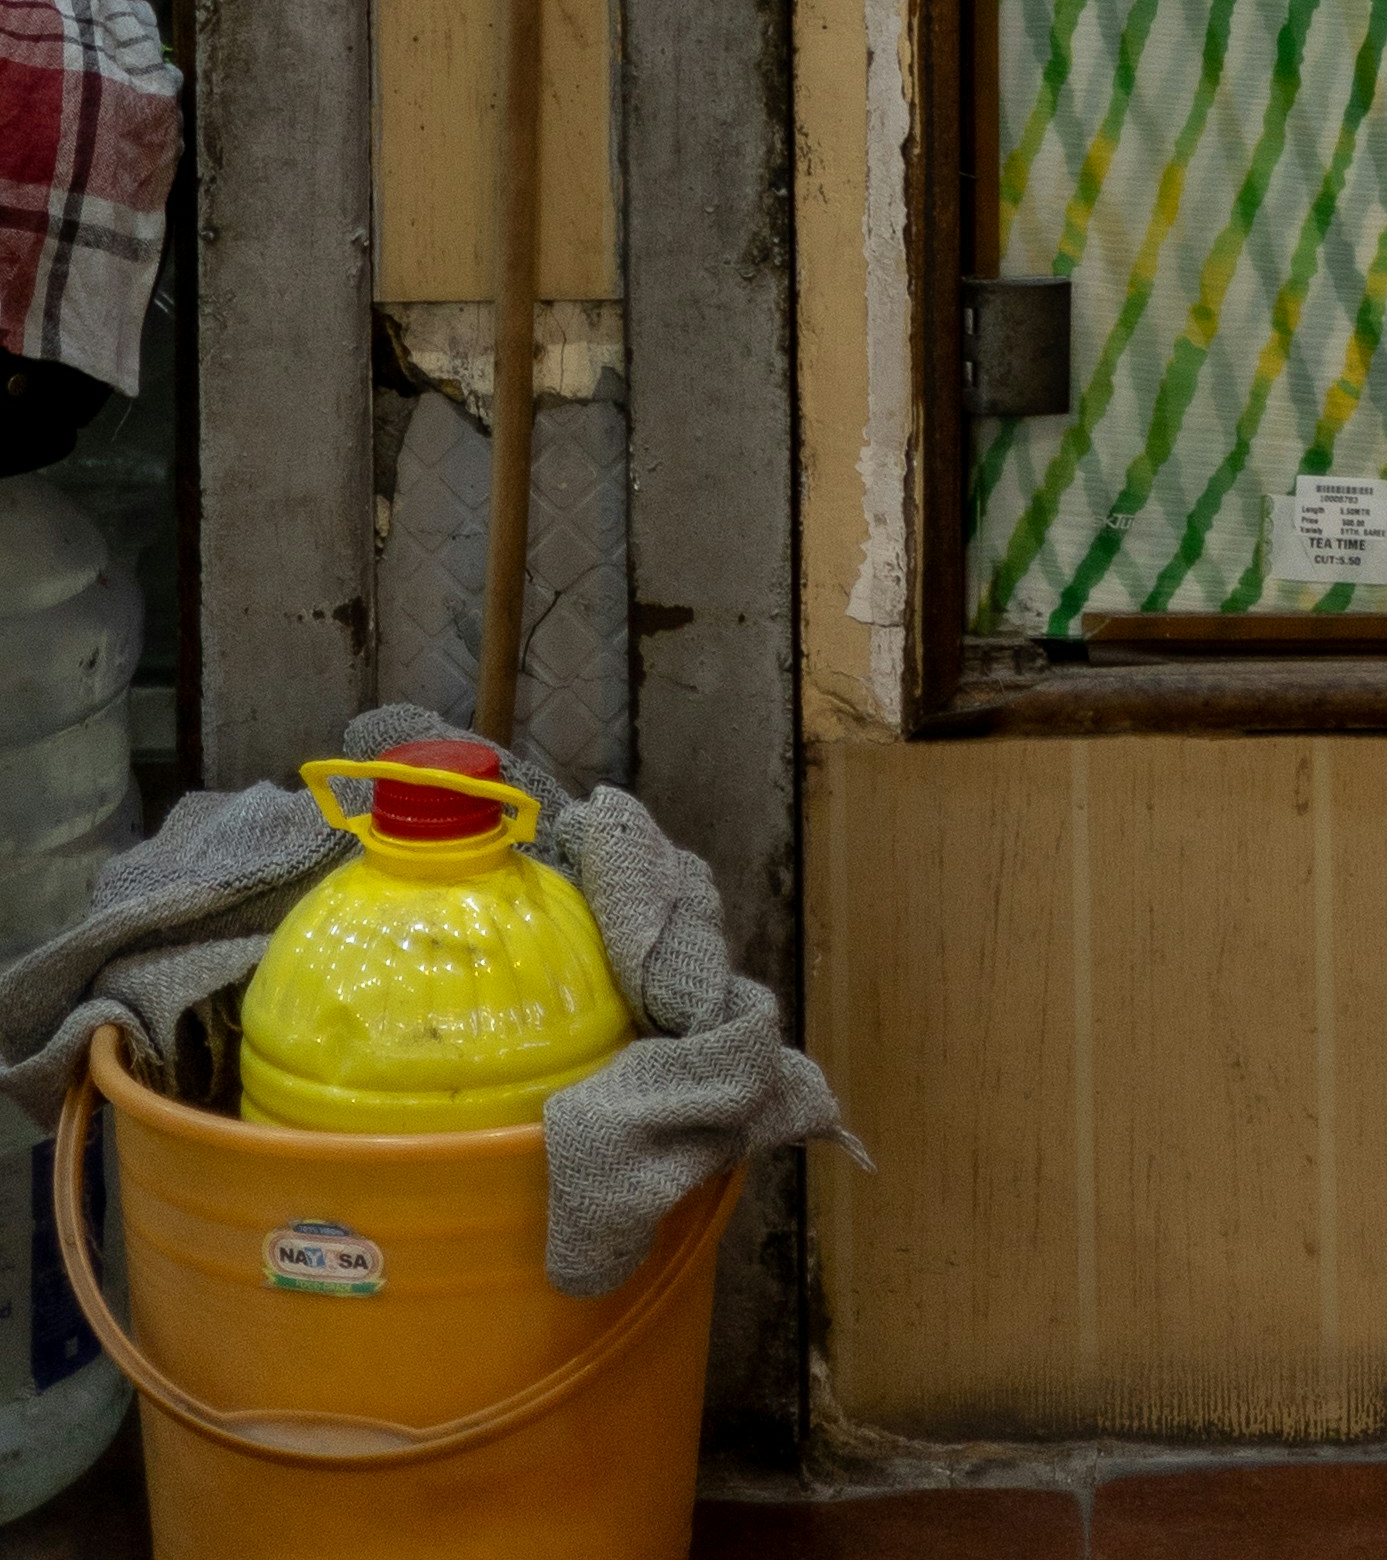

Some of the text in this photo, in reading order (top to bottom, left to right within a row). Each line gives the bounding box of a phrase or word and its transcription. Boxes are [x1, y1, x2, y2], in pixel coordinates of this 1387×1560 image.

[1302, 506, 1325, 514] Length
[1309, 537, 1366, 551] TEA TIME
